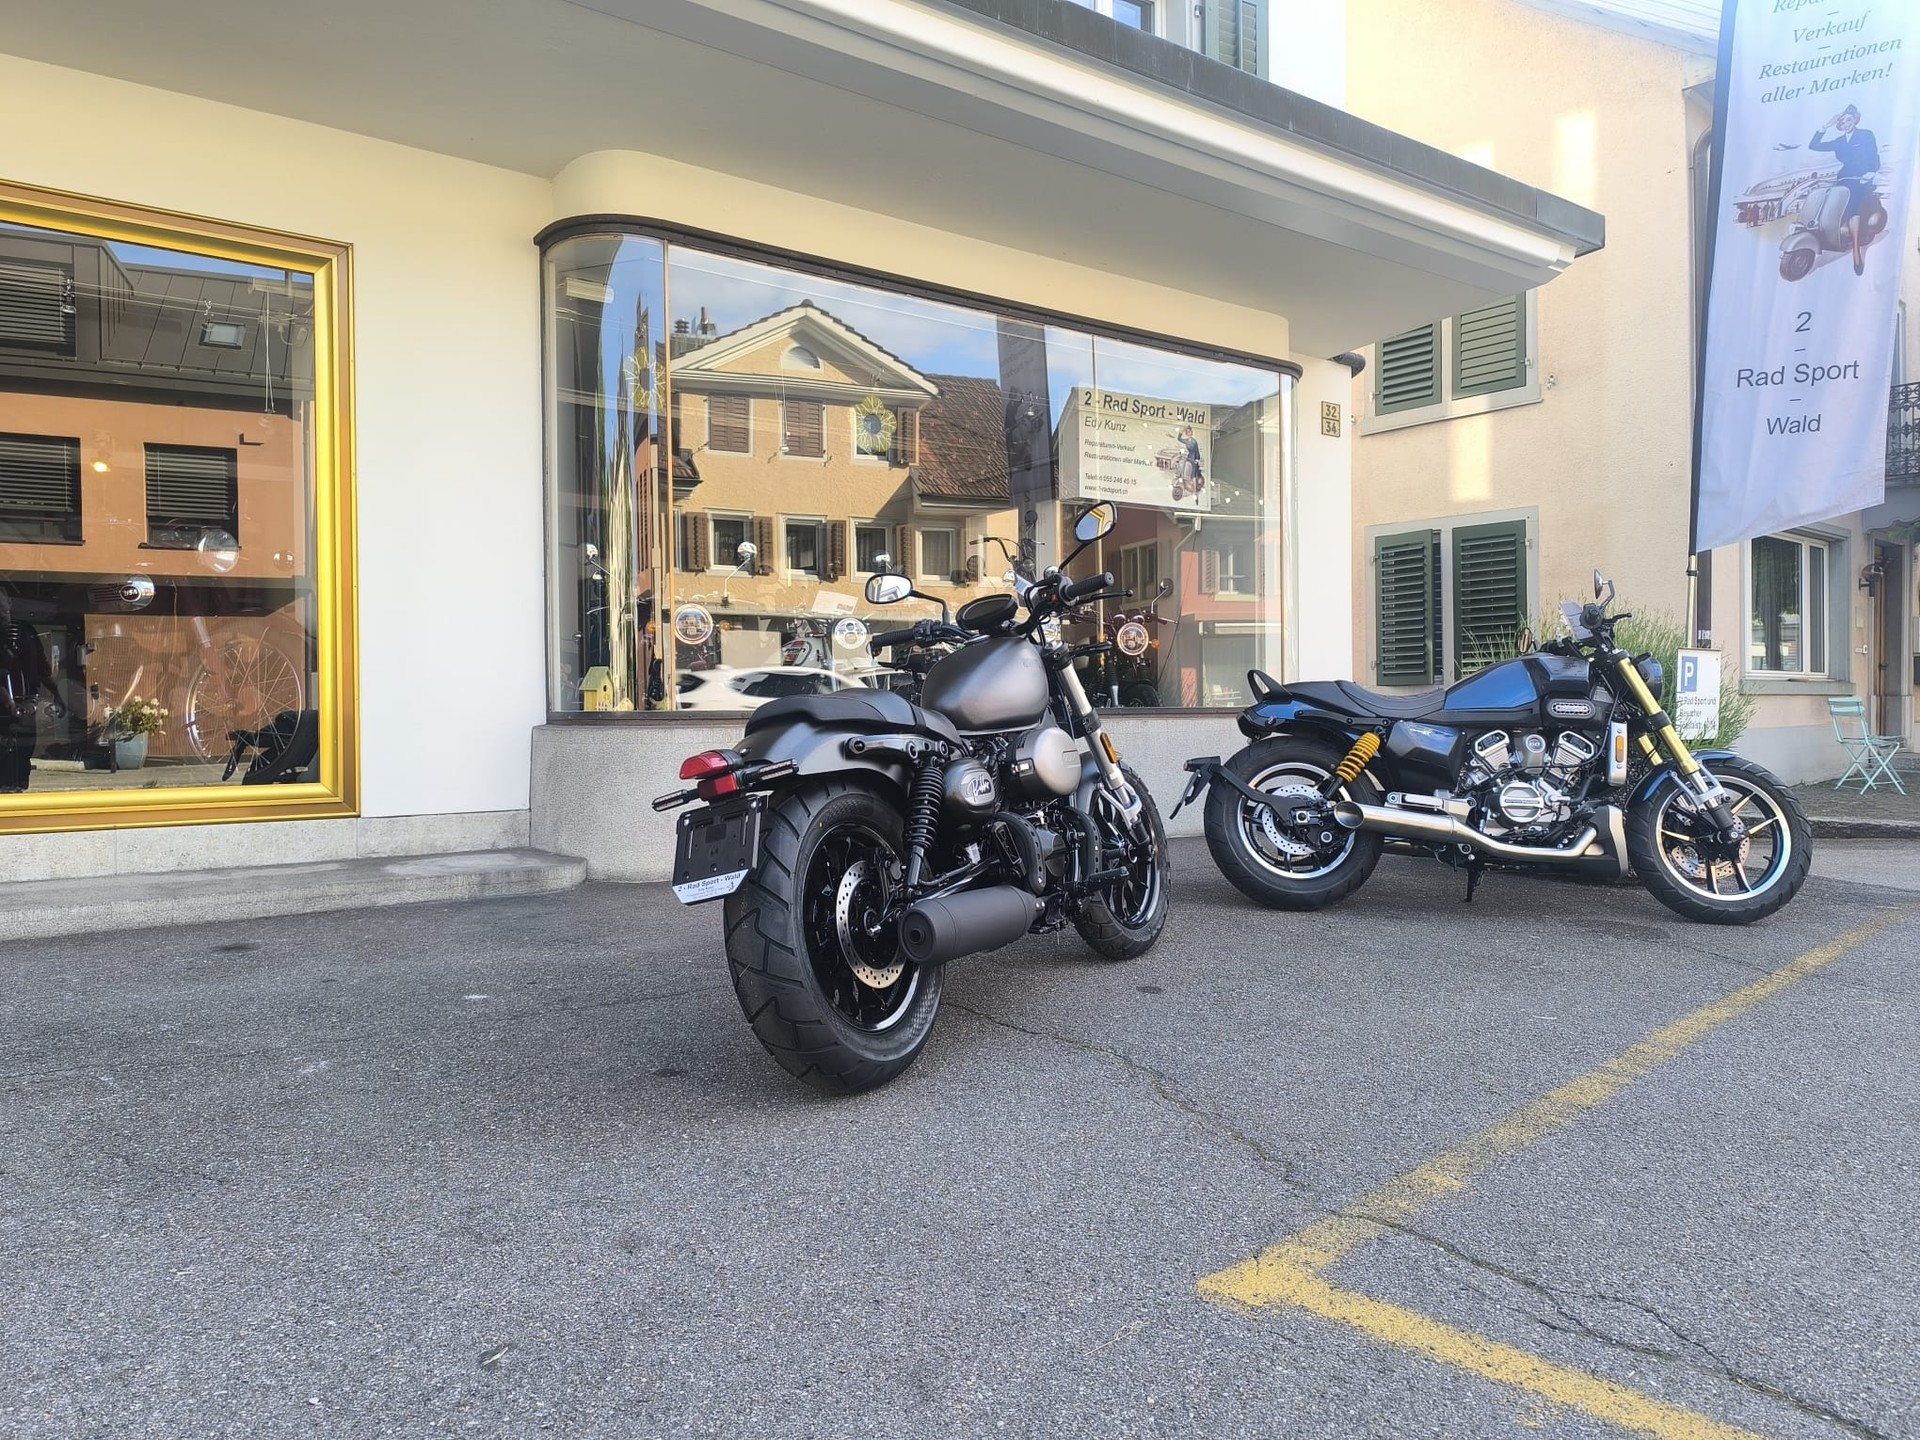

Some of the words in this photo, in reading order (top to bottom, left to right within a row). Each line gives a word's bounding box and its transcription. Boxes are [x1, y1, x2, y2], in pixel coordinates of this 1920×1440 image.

[1793, 10, 1871, 43] Verkauf
[1758, 38, 1902, 80] Restaurationen
[1761, 85, 1804, 103] aller
[1808, 62, 1893, 95] Marken!
[1795, 311, 1812, 333] 2
[1736, 365, 1785, 388] Rad
[1793, 360, 1860, 386] Sport
[1084, 391, 1092, 406] 2
[1103, 394, 1128, 412] Rad
[1132, 399, 1165, 418] Sport
[1176, 406, 1205, 424] Wald
[1325, 404, 1337, 418] 32
[1104, 419, 1127, 433] Kunz
[1325, 421, 1337, 434] 34
[1766, 413, 1821, 435] Wald
[1684, 661, 1694, 687] P
[701, 878, 719, 887] Sport
